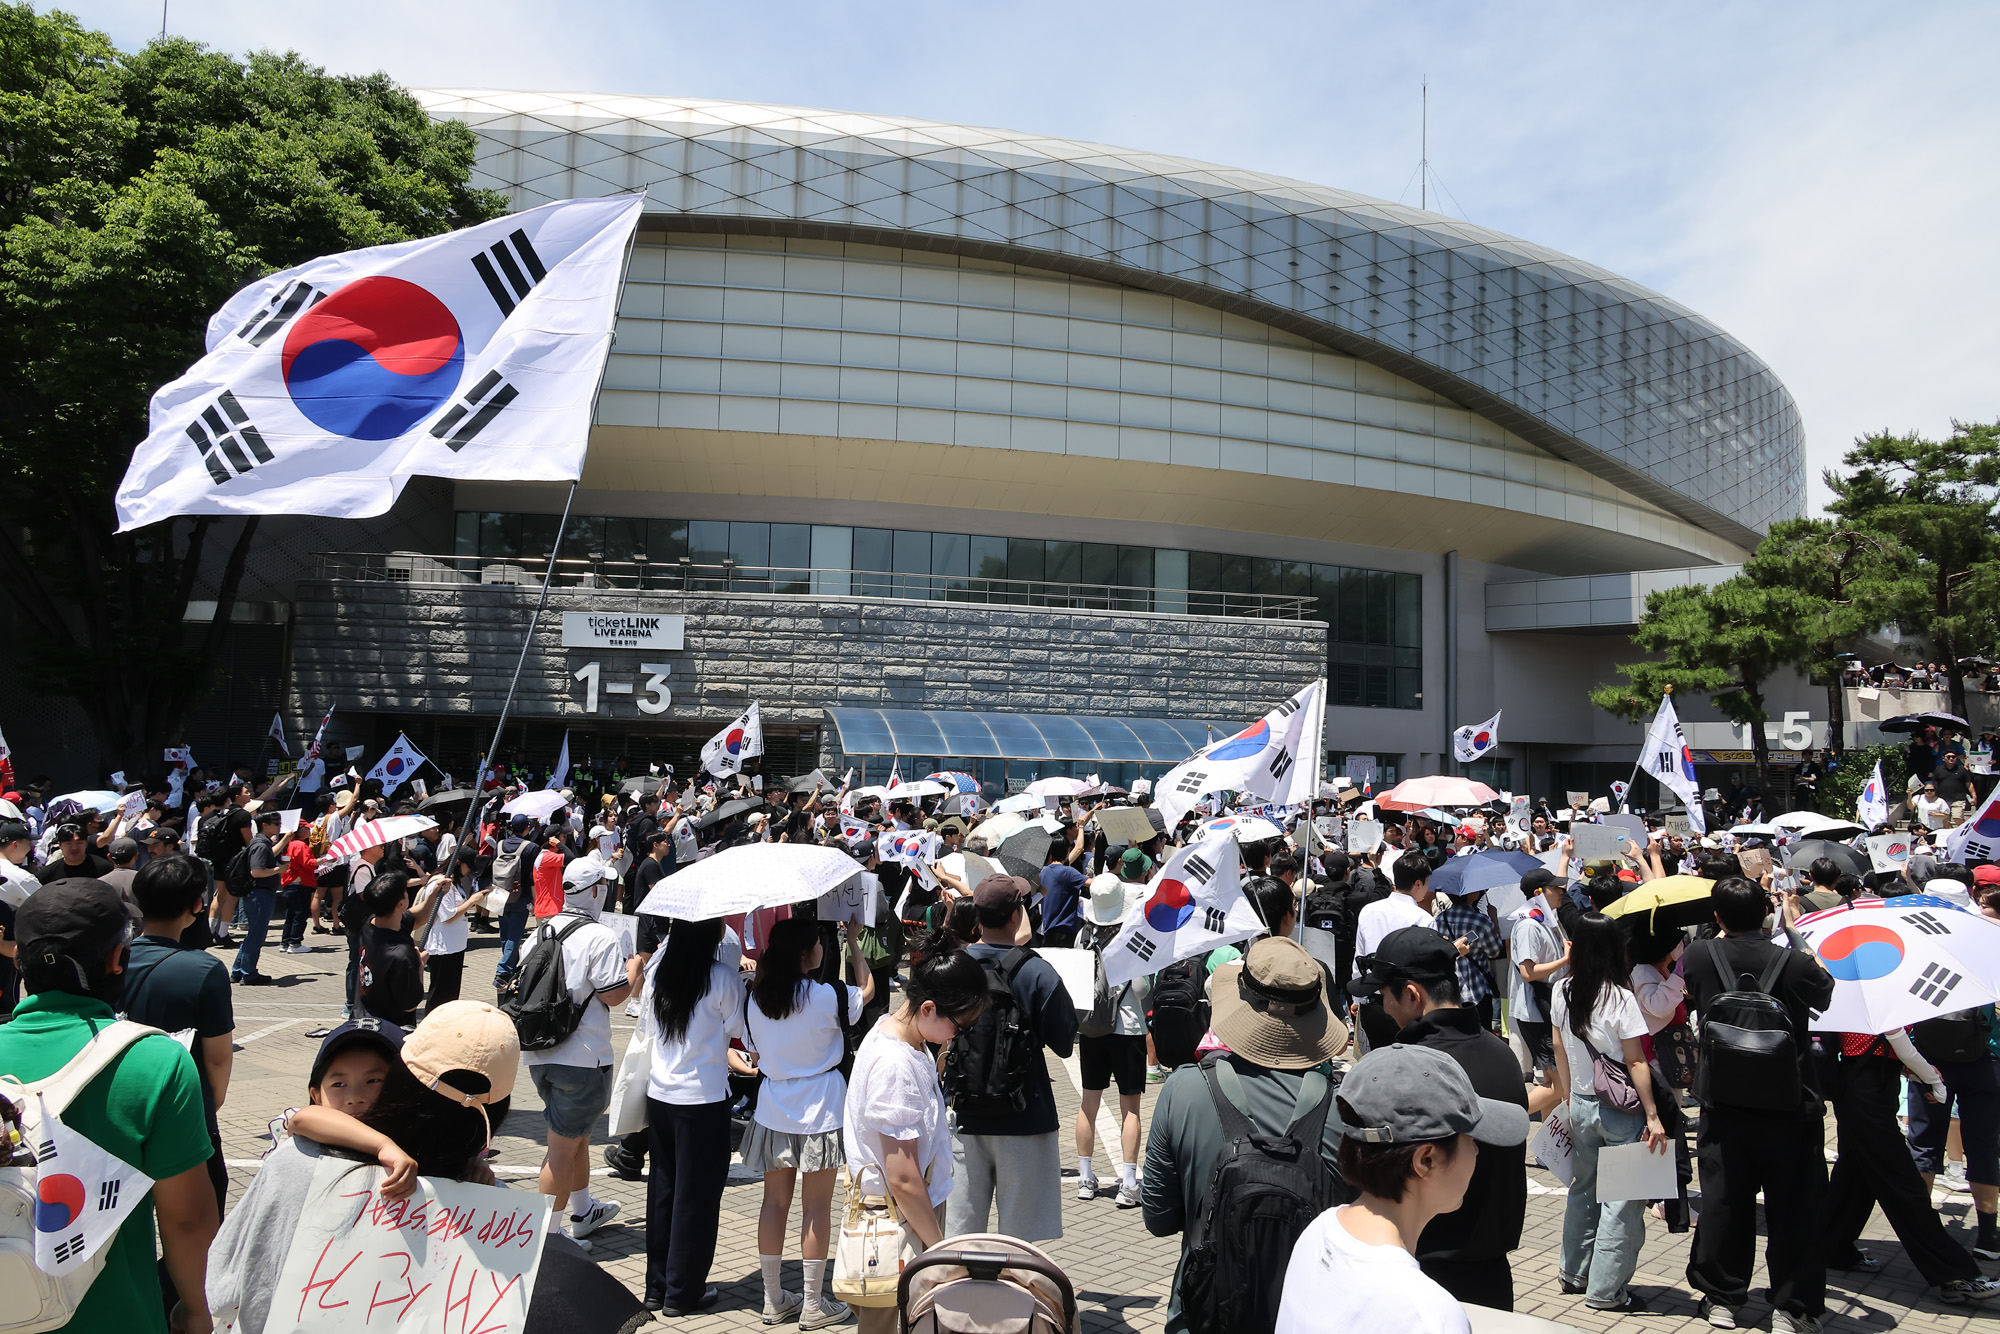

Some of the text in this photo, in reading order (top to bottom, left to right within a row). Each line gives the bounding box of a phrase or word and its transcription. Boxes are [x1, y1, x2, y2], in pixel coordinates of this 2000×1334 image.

[588, 616, 659, 629] ticketLINK
[573, 661, 672, 715] 1-3
[1346, 757, 1375, 777] 재선거
[1722, 751, 1752, 761] 2026
[340, 1189, 533, 1249] STOP THE STEAL
[297, 1235, 522, 1334] 재선거
